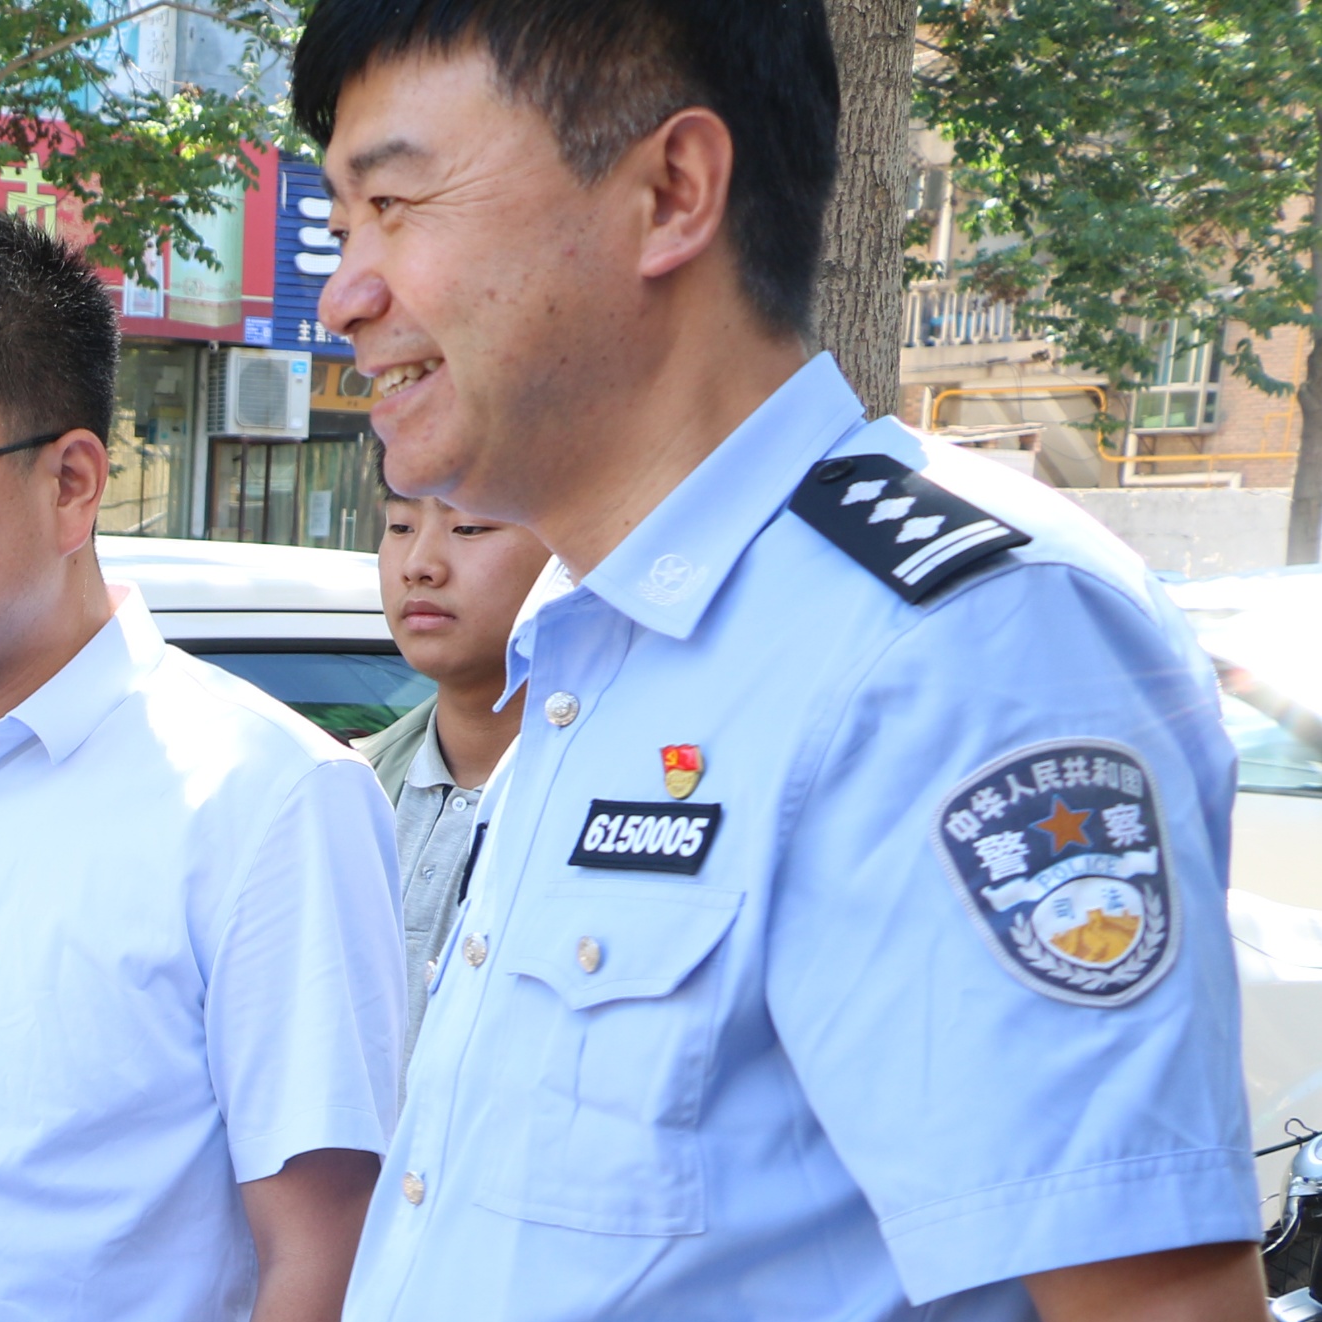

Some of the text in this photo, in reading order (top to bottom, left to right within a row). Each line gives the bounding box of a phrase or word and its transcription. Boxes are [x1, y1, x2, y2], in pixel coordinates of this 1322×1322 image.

[945, 754, 1144, 843] 中华人民共和国
[582, 812, 709, 857] 6150005
[972, 802, 1147, 883] 警 察
[1035, 852, 1117, 890] POLICE
